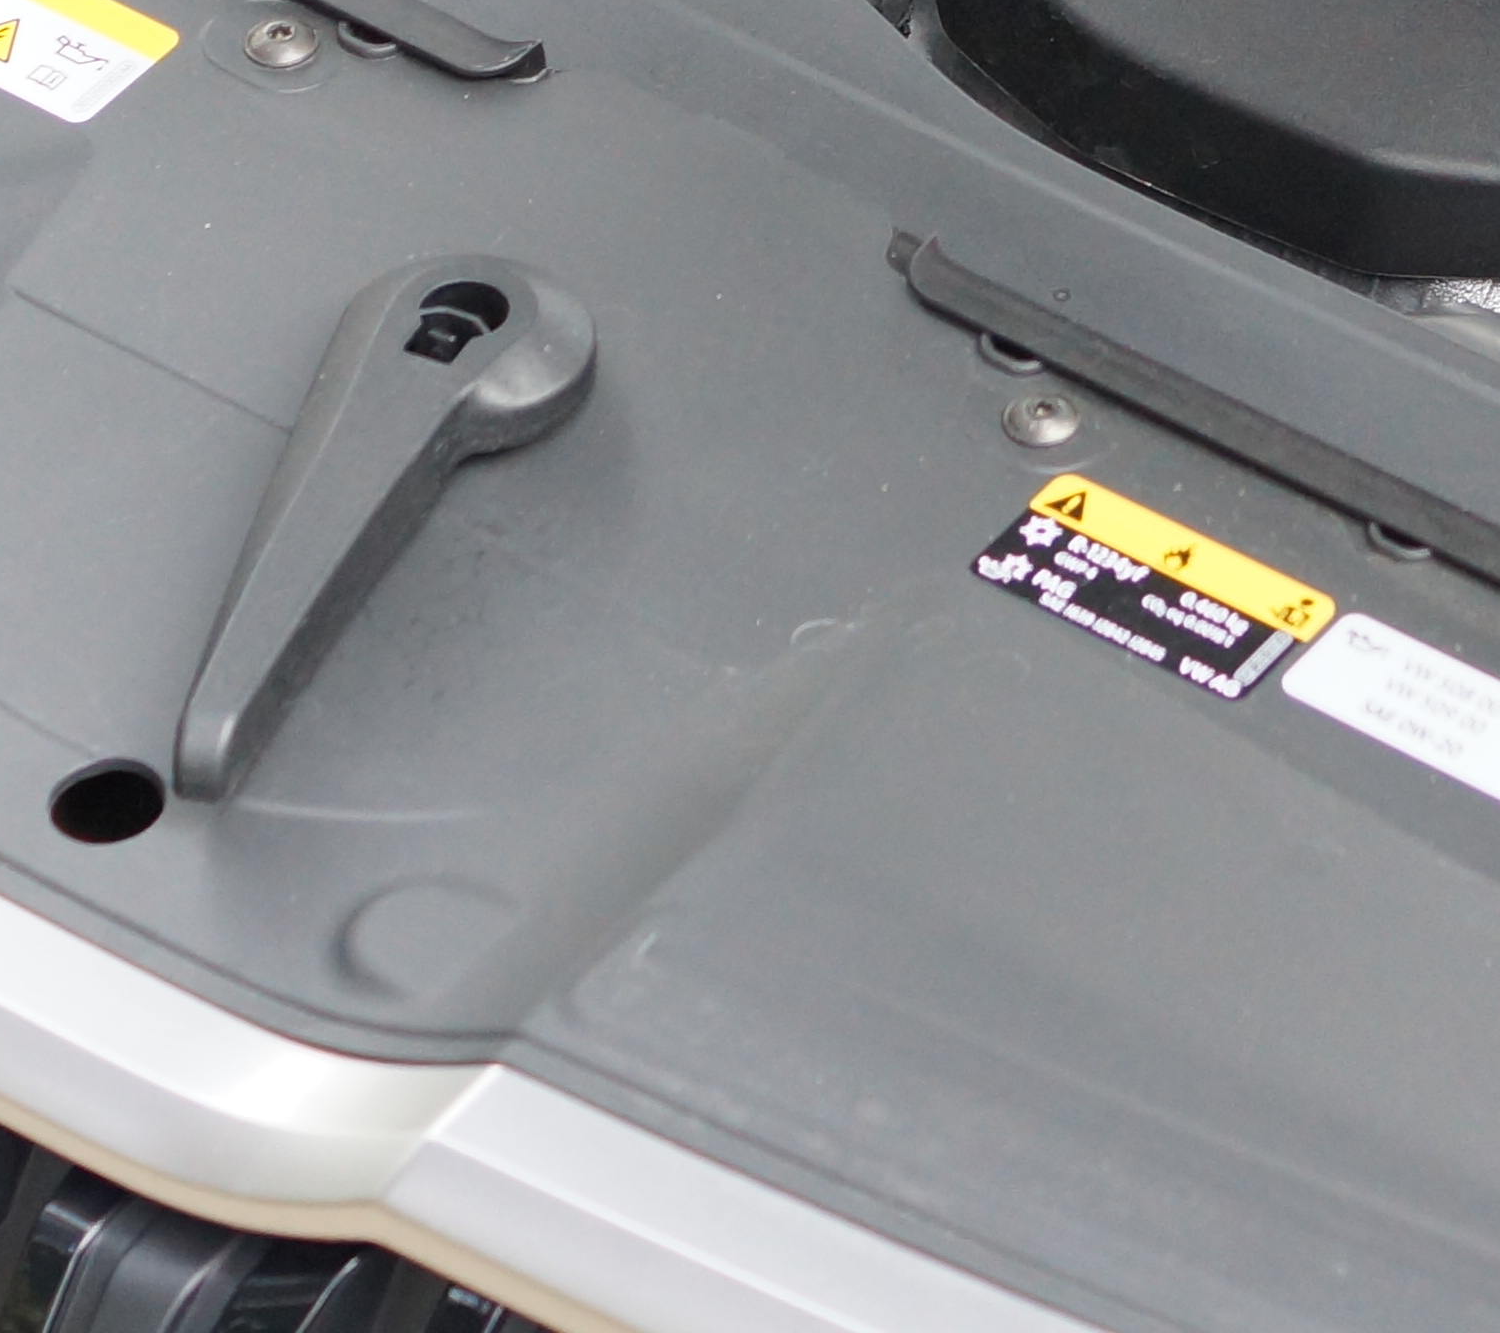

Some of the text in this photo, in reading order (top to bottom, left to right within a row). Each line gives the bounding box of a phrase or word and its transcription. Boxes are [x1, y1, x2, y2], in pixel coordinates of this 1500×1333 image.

[1031, 568, 1077, 600] PAG
[1179, 655, 1215, 684] VW
[1207, 674, 1242, 699] AG
